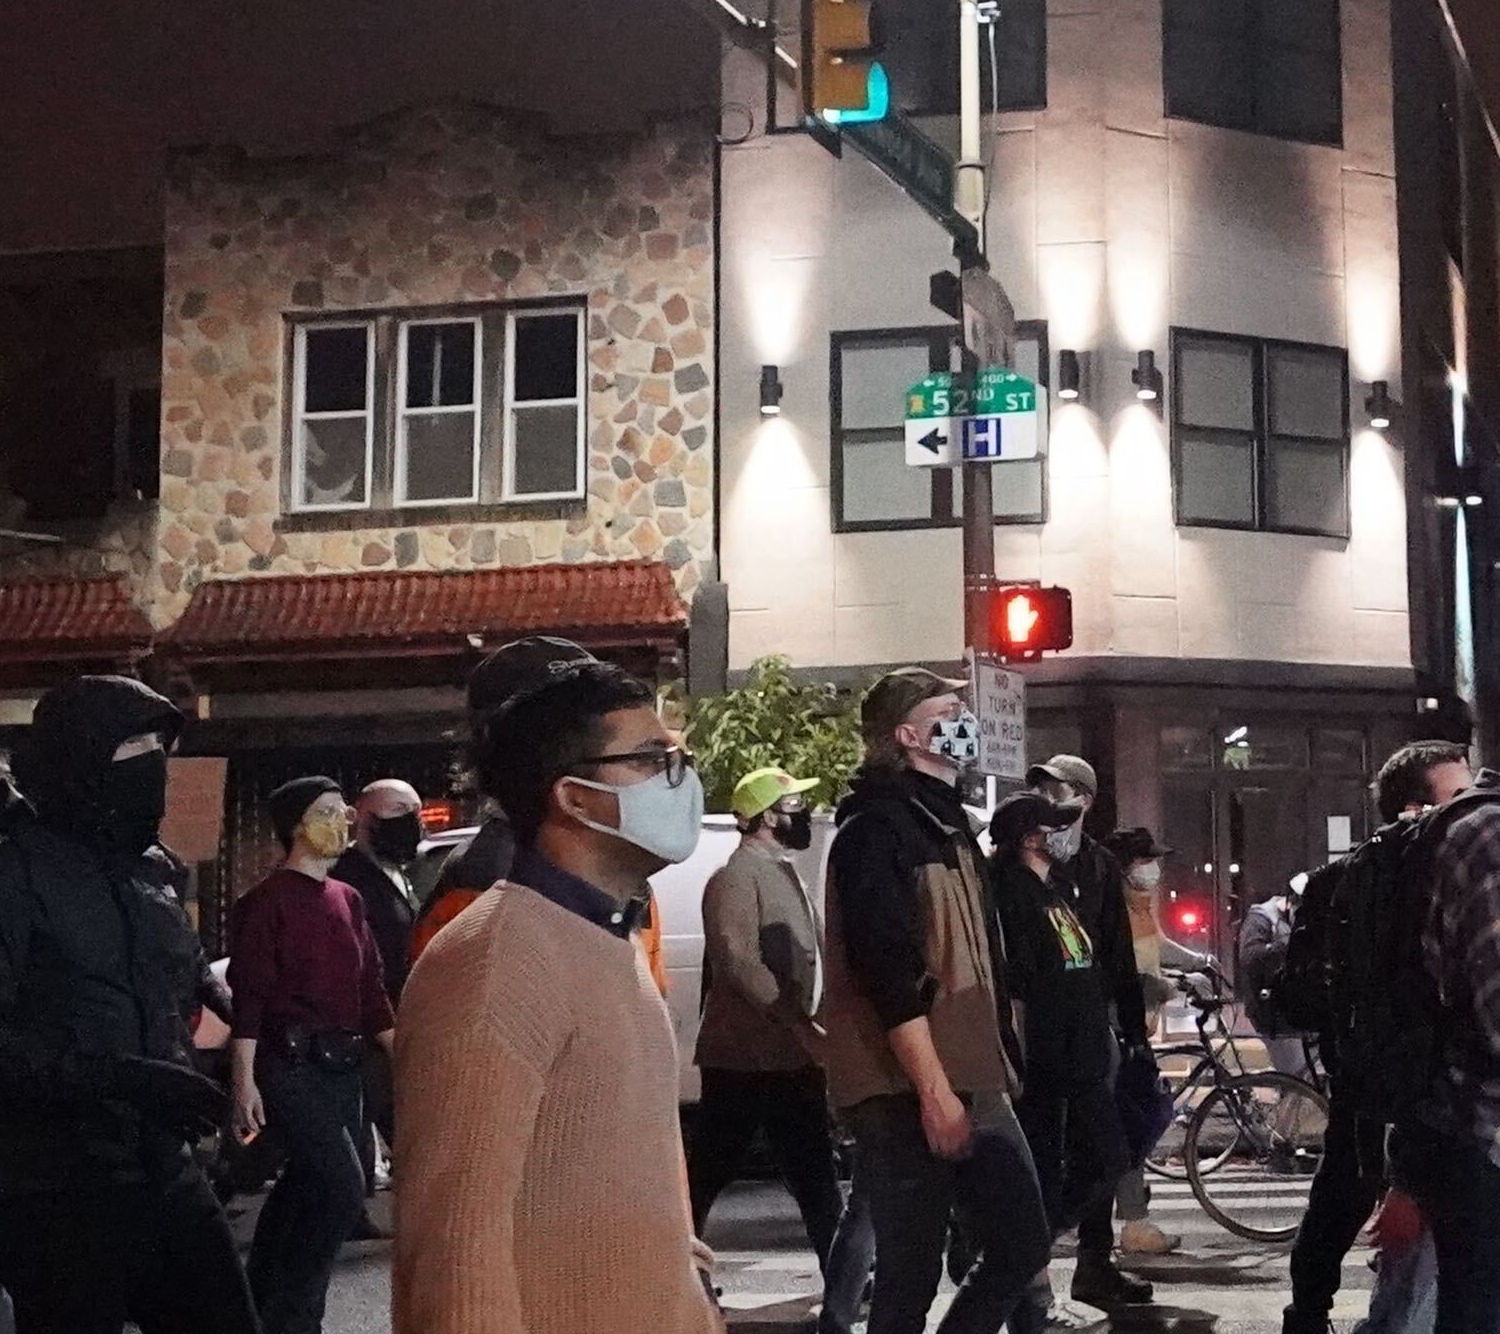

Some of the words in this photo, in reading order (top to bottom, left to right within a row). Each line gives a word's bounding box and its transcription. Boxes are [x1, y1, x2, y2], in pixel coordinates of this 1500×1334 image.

[1006, 392, 1031, 410] ST
[994, 673, 1009, 691] NO
[981, 719, 997, 737] ON
[1001, 722, 1023, 742] RED
